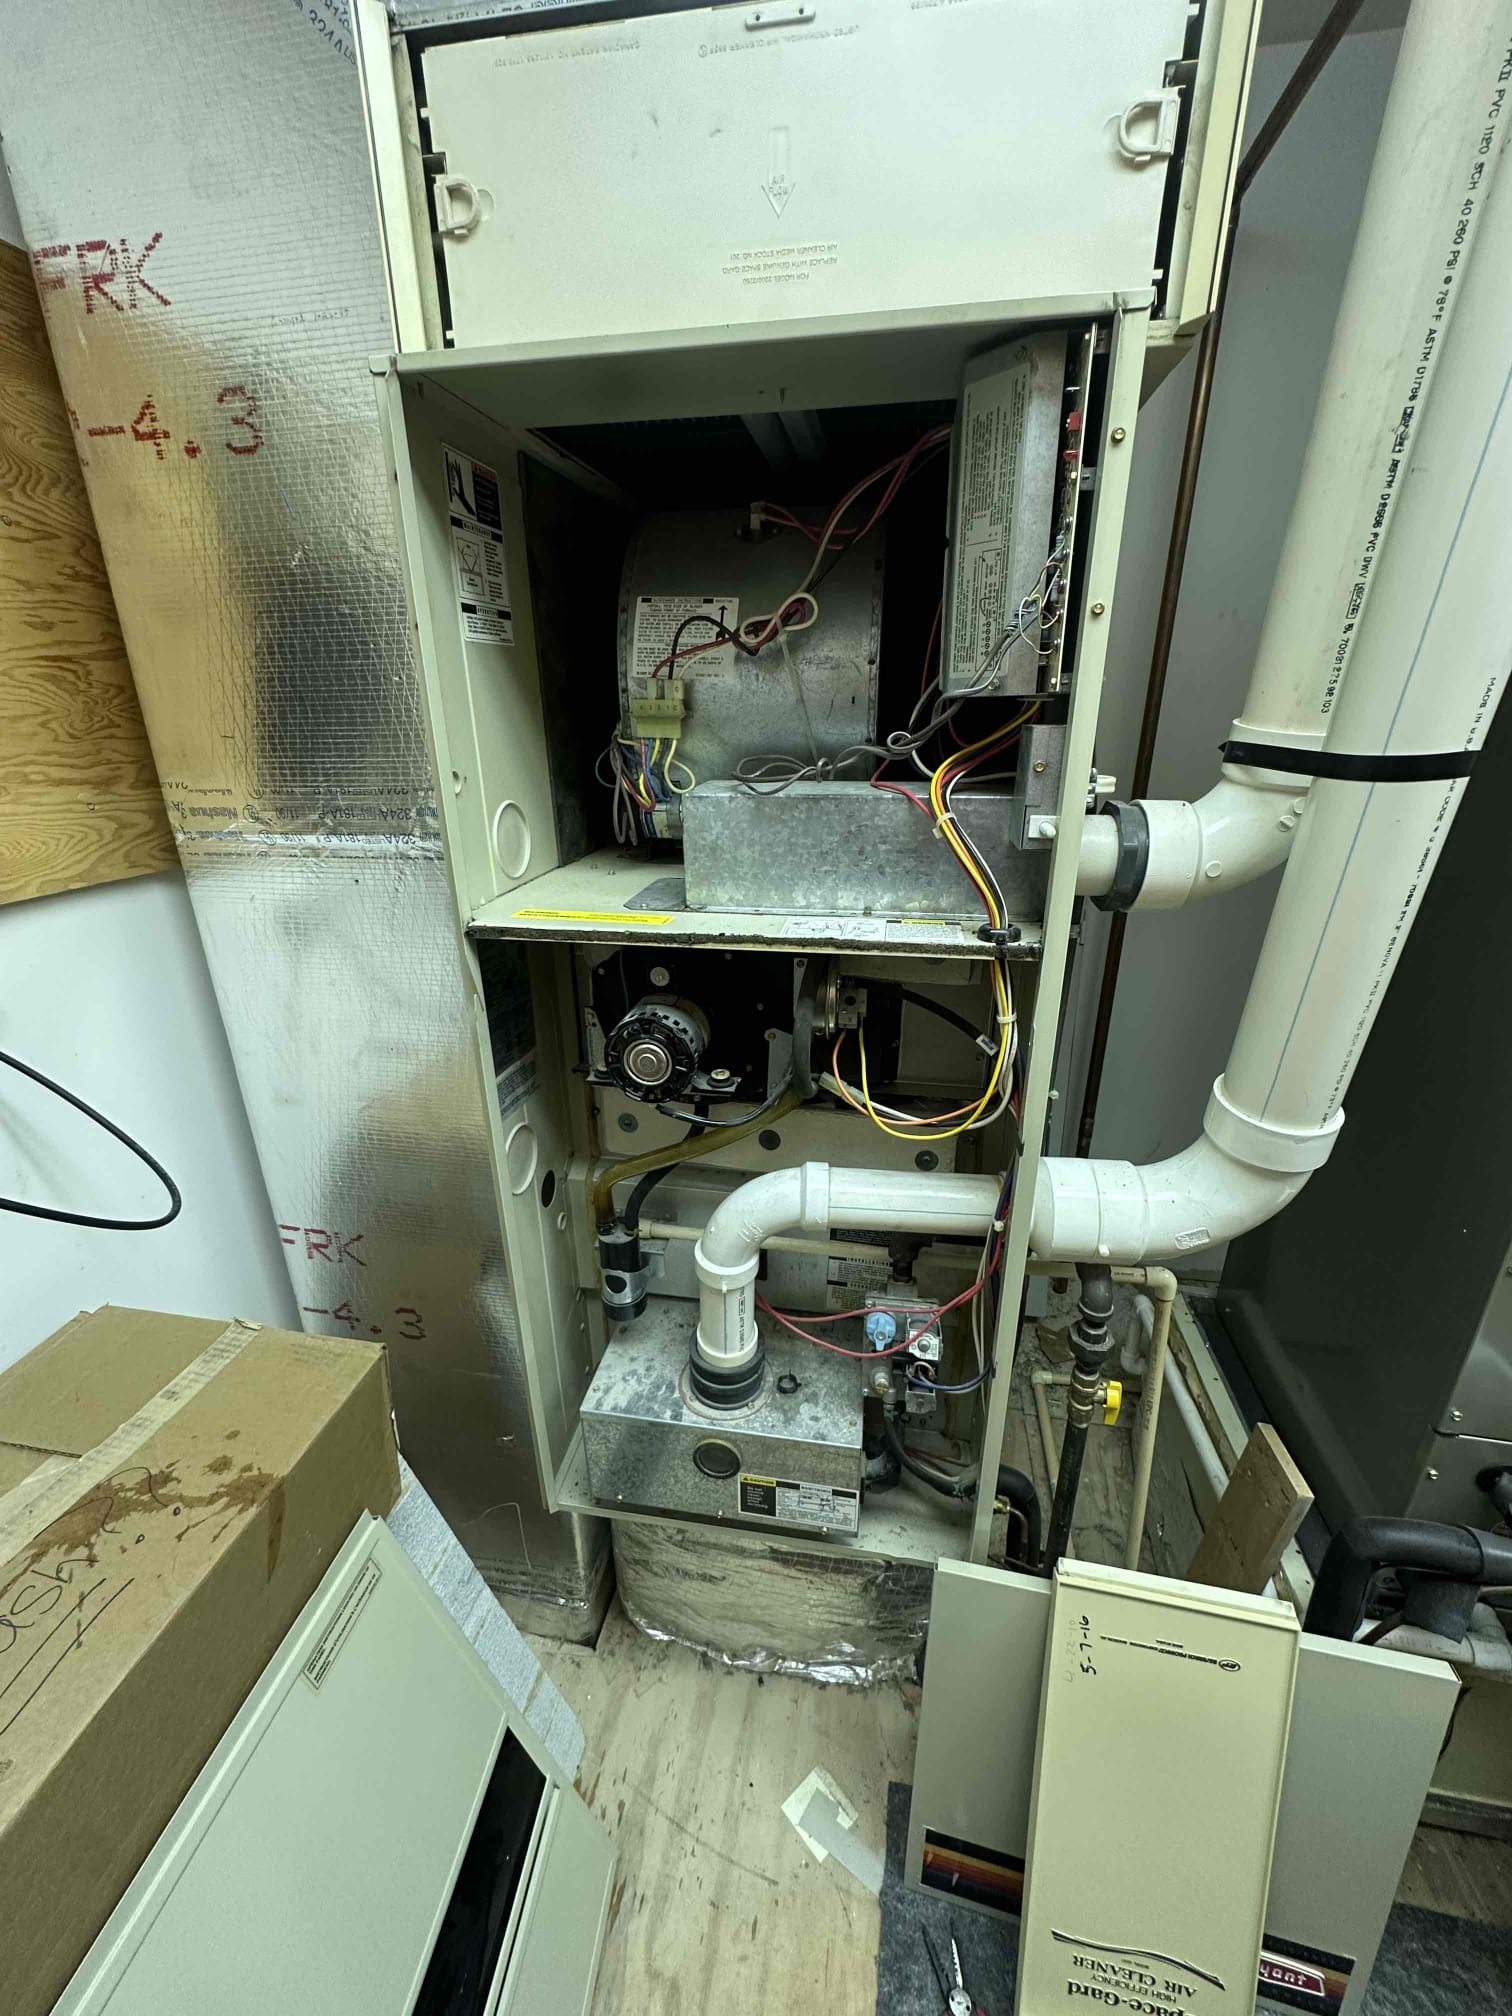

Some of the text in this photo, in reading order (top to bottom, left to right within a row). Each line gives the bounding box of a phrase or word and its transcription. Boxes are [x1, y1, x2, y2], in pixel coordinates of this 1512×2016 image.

[1488, 88, 1505, 119] PVC
[1478, 124, 1496, 155] 1120
[1467, 161, 1485, 190] SCH
[1461, 198, 1474, 216] 40
[1453, 219, 1469, 245] 260
[754, 249, 775, 259] STOCK
[797, 244, 826, 255] CLEANER
[763, 262, 790, 271] GENUINE
[791, 260, 808, 268] WITH
[809, 256, 838, 266] REPLACE
[1444, 249, 1460, 270] PSI
[774, 274, 796, 282] MODEL
[796, 272, 810, 280] FOR
[1420, 328, 1437, 362] ASTM
[1366, 532, 1379, 552] PVC
[1358, 556, 1373, 579] DWV
[1474, 712, 1484, 724] IN
[275, 807, 299, 820] 11/90
[380, 806, 412, 821] 324A
[384, 833, 418, 845] 324A
[1079, 1615, 1098, 1676] 5-7-16
[1072, 1955, 1198, 1998] AIR CLEANER
[1067, 1980, 1188, 2016] pace-Gard
[1091, 1973, 1178, 2004] HIGH EFFICIENCY
